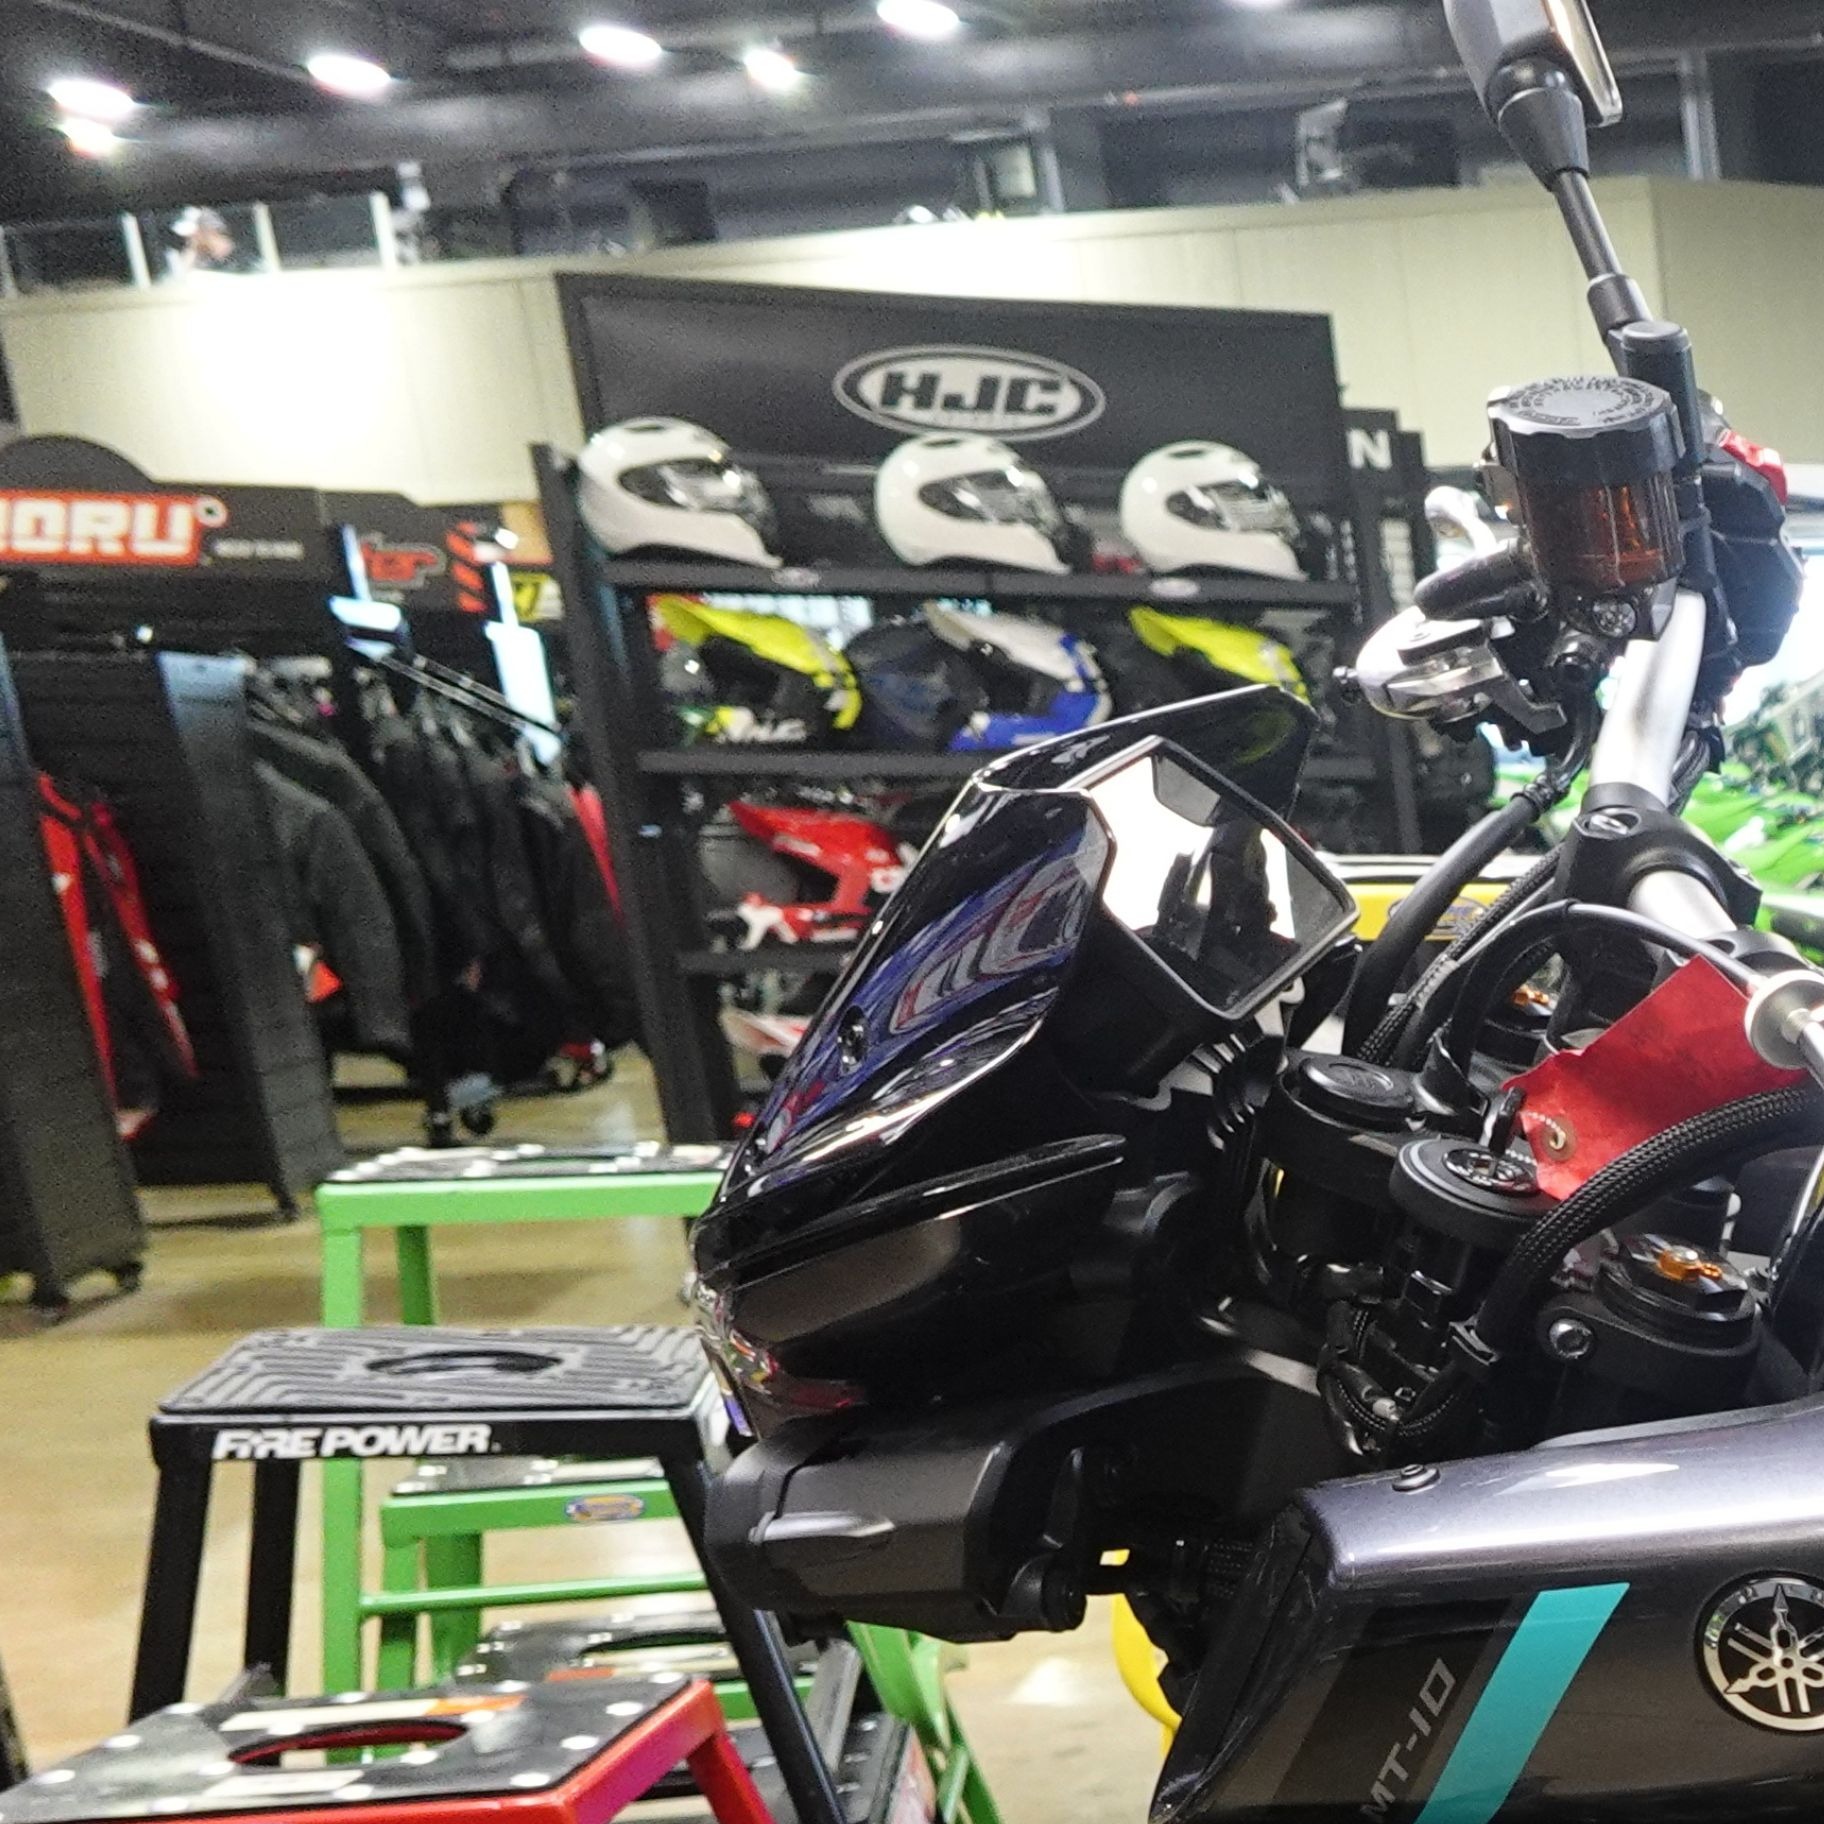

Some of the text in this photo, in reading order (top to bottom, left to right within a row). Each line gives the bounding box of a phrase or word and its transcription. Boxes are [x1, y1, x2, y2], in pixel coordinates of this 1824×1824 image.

[881, 370, 1062, 415] HJC
[0, 496, 197, 558] ORU
[320, 1423, 492, 1458] POWER
